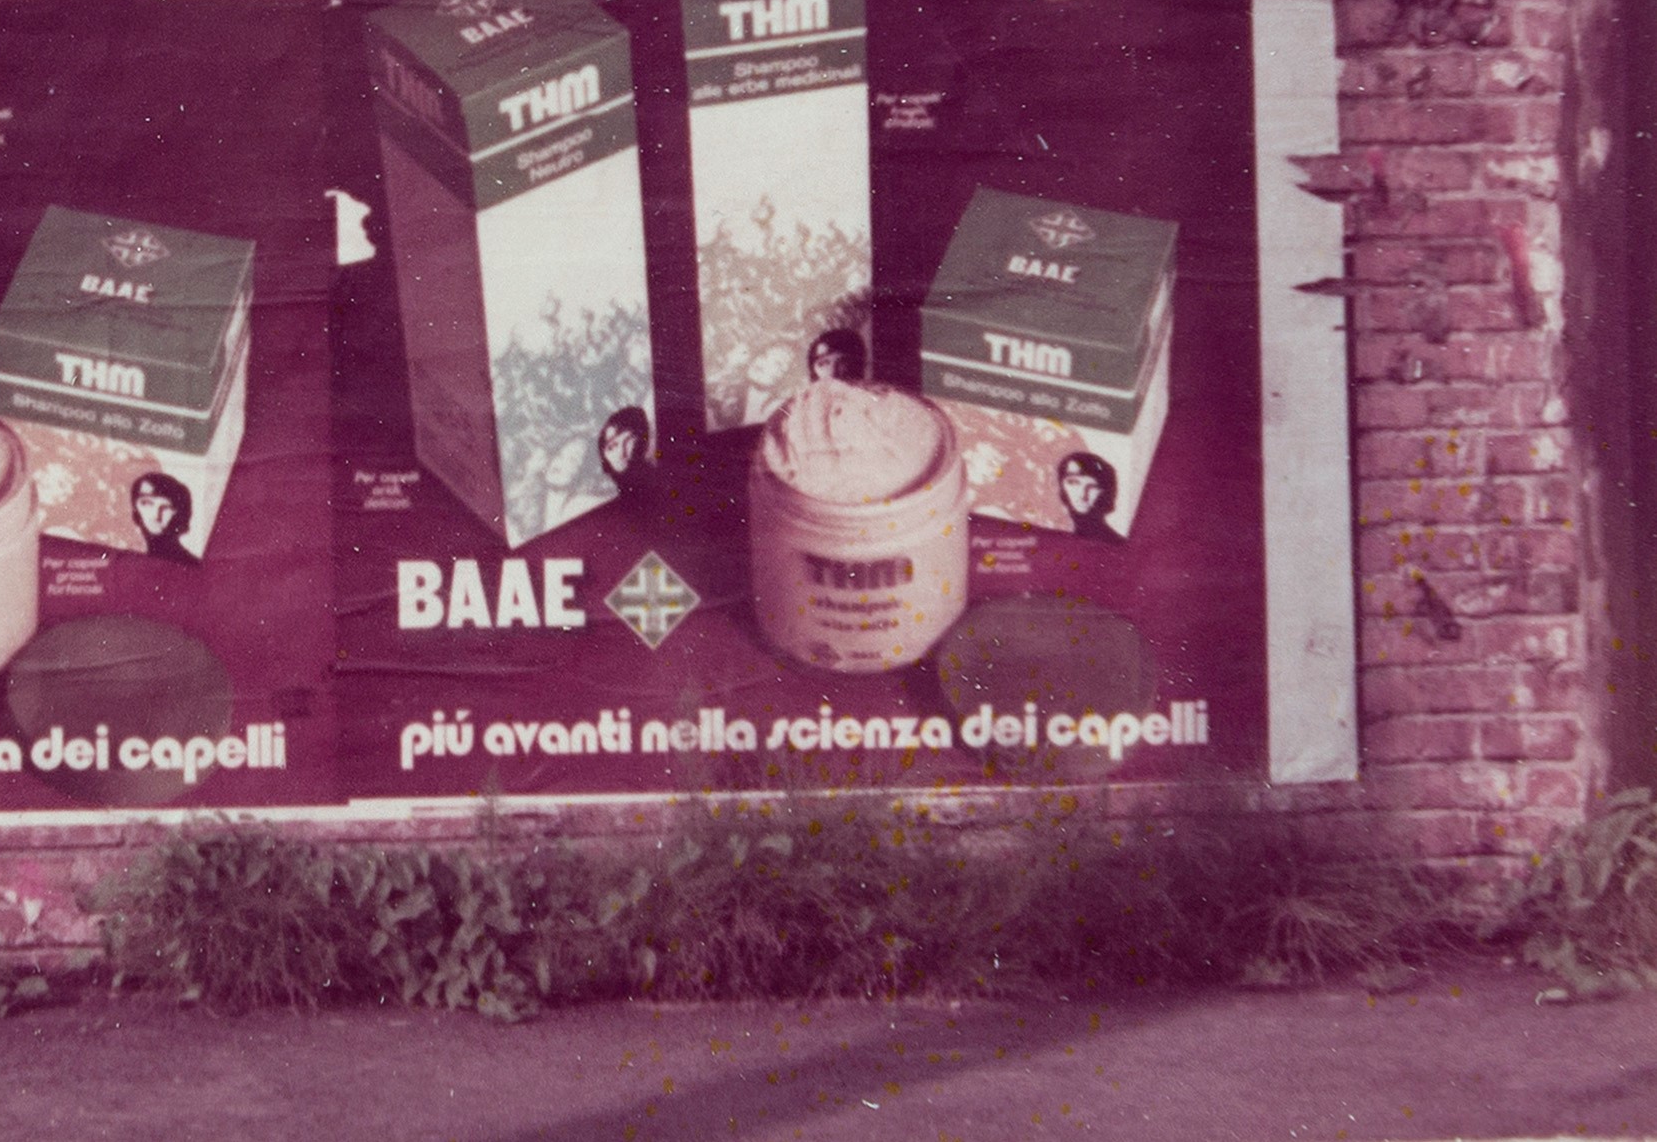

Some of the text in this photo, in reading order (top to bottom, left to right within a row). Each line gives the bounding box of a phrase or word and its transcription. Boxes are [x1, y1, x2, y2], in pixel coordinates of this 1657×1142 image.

[461, 9, 534, 44] BAAE
[728, 78, 769, 95] erbe
[734, 56, 819, 78] Shampoo
[499, 64, 601, 132] THM
[80, 274, 154, 303] BAAE
[1007, 255, 1080, 283] BAAE
[55, 352, 145, 397] THM
[983, 332, 1072, 377] THM
[942, 372, 1025, 402] Shampoo
[396, 558, 585, 630] BAAE
[482, 710, 631, 756] avanti
[640, 709, 758, 754] nella
[765, 705, 953, 751] scienza
[960, 703, 1038, 747] dei
[1046, 700, 1209, 760] capelli
[30, 725, 110, 772] dei
[118, 722, 286, 783] capelli
